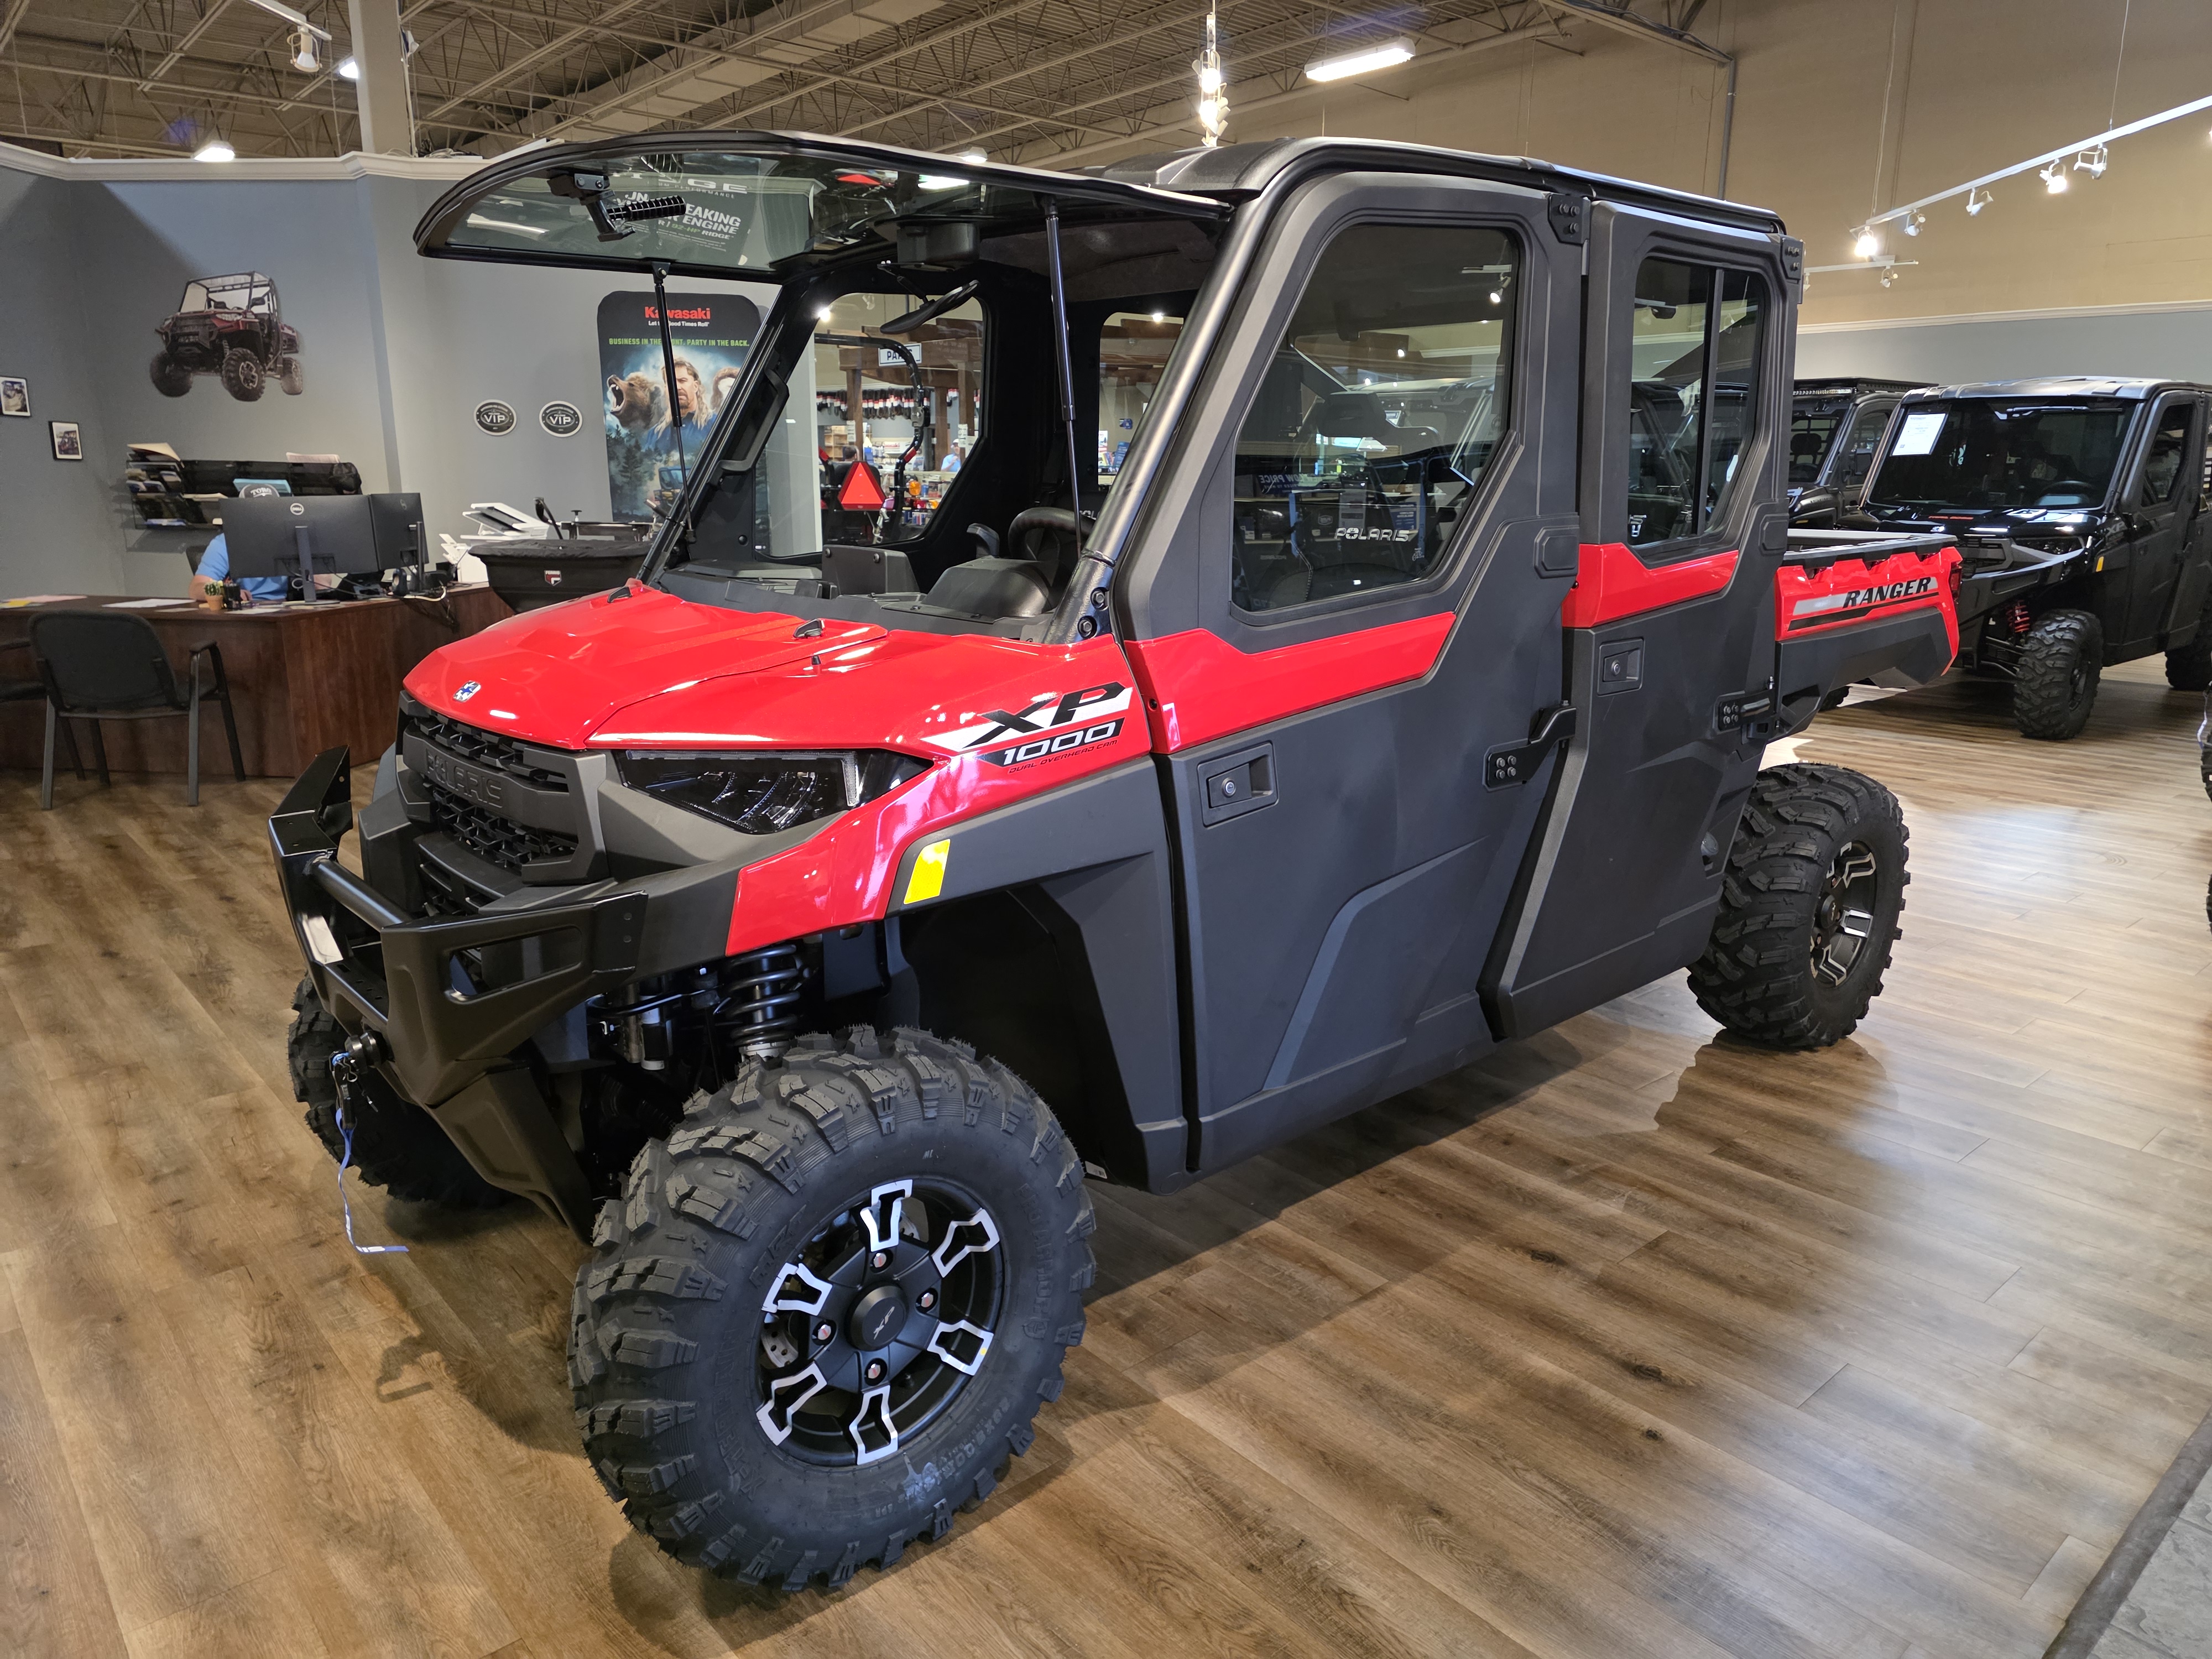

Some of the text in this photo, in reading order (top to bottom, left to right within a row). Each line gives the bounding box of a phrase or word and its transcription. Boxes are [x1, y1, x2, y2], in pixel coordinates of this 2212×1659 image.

[671, 223, 701, 233] 92-HP
[682, 215, 739, 234] ENGINE
[484, 414, 505, 423] VIP
[550, 416, 571, 425] VIP
[251, 487, 272, 495] TORO
[1334, 528, 1410, 542] POLARIS
[1843, 576, 1931, 608] RANGER
[962, 682, 1126, 749] XP
[1003, 722, 1116, 765] 1000
[1009, 740, 1117, 773] DUAL OVERHEAD CAM
[426, 748, 503, 808] POLARIS
[873, 1306, 895, 1340] XP
